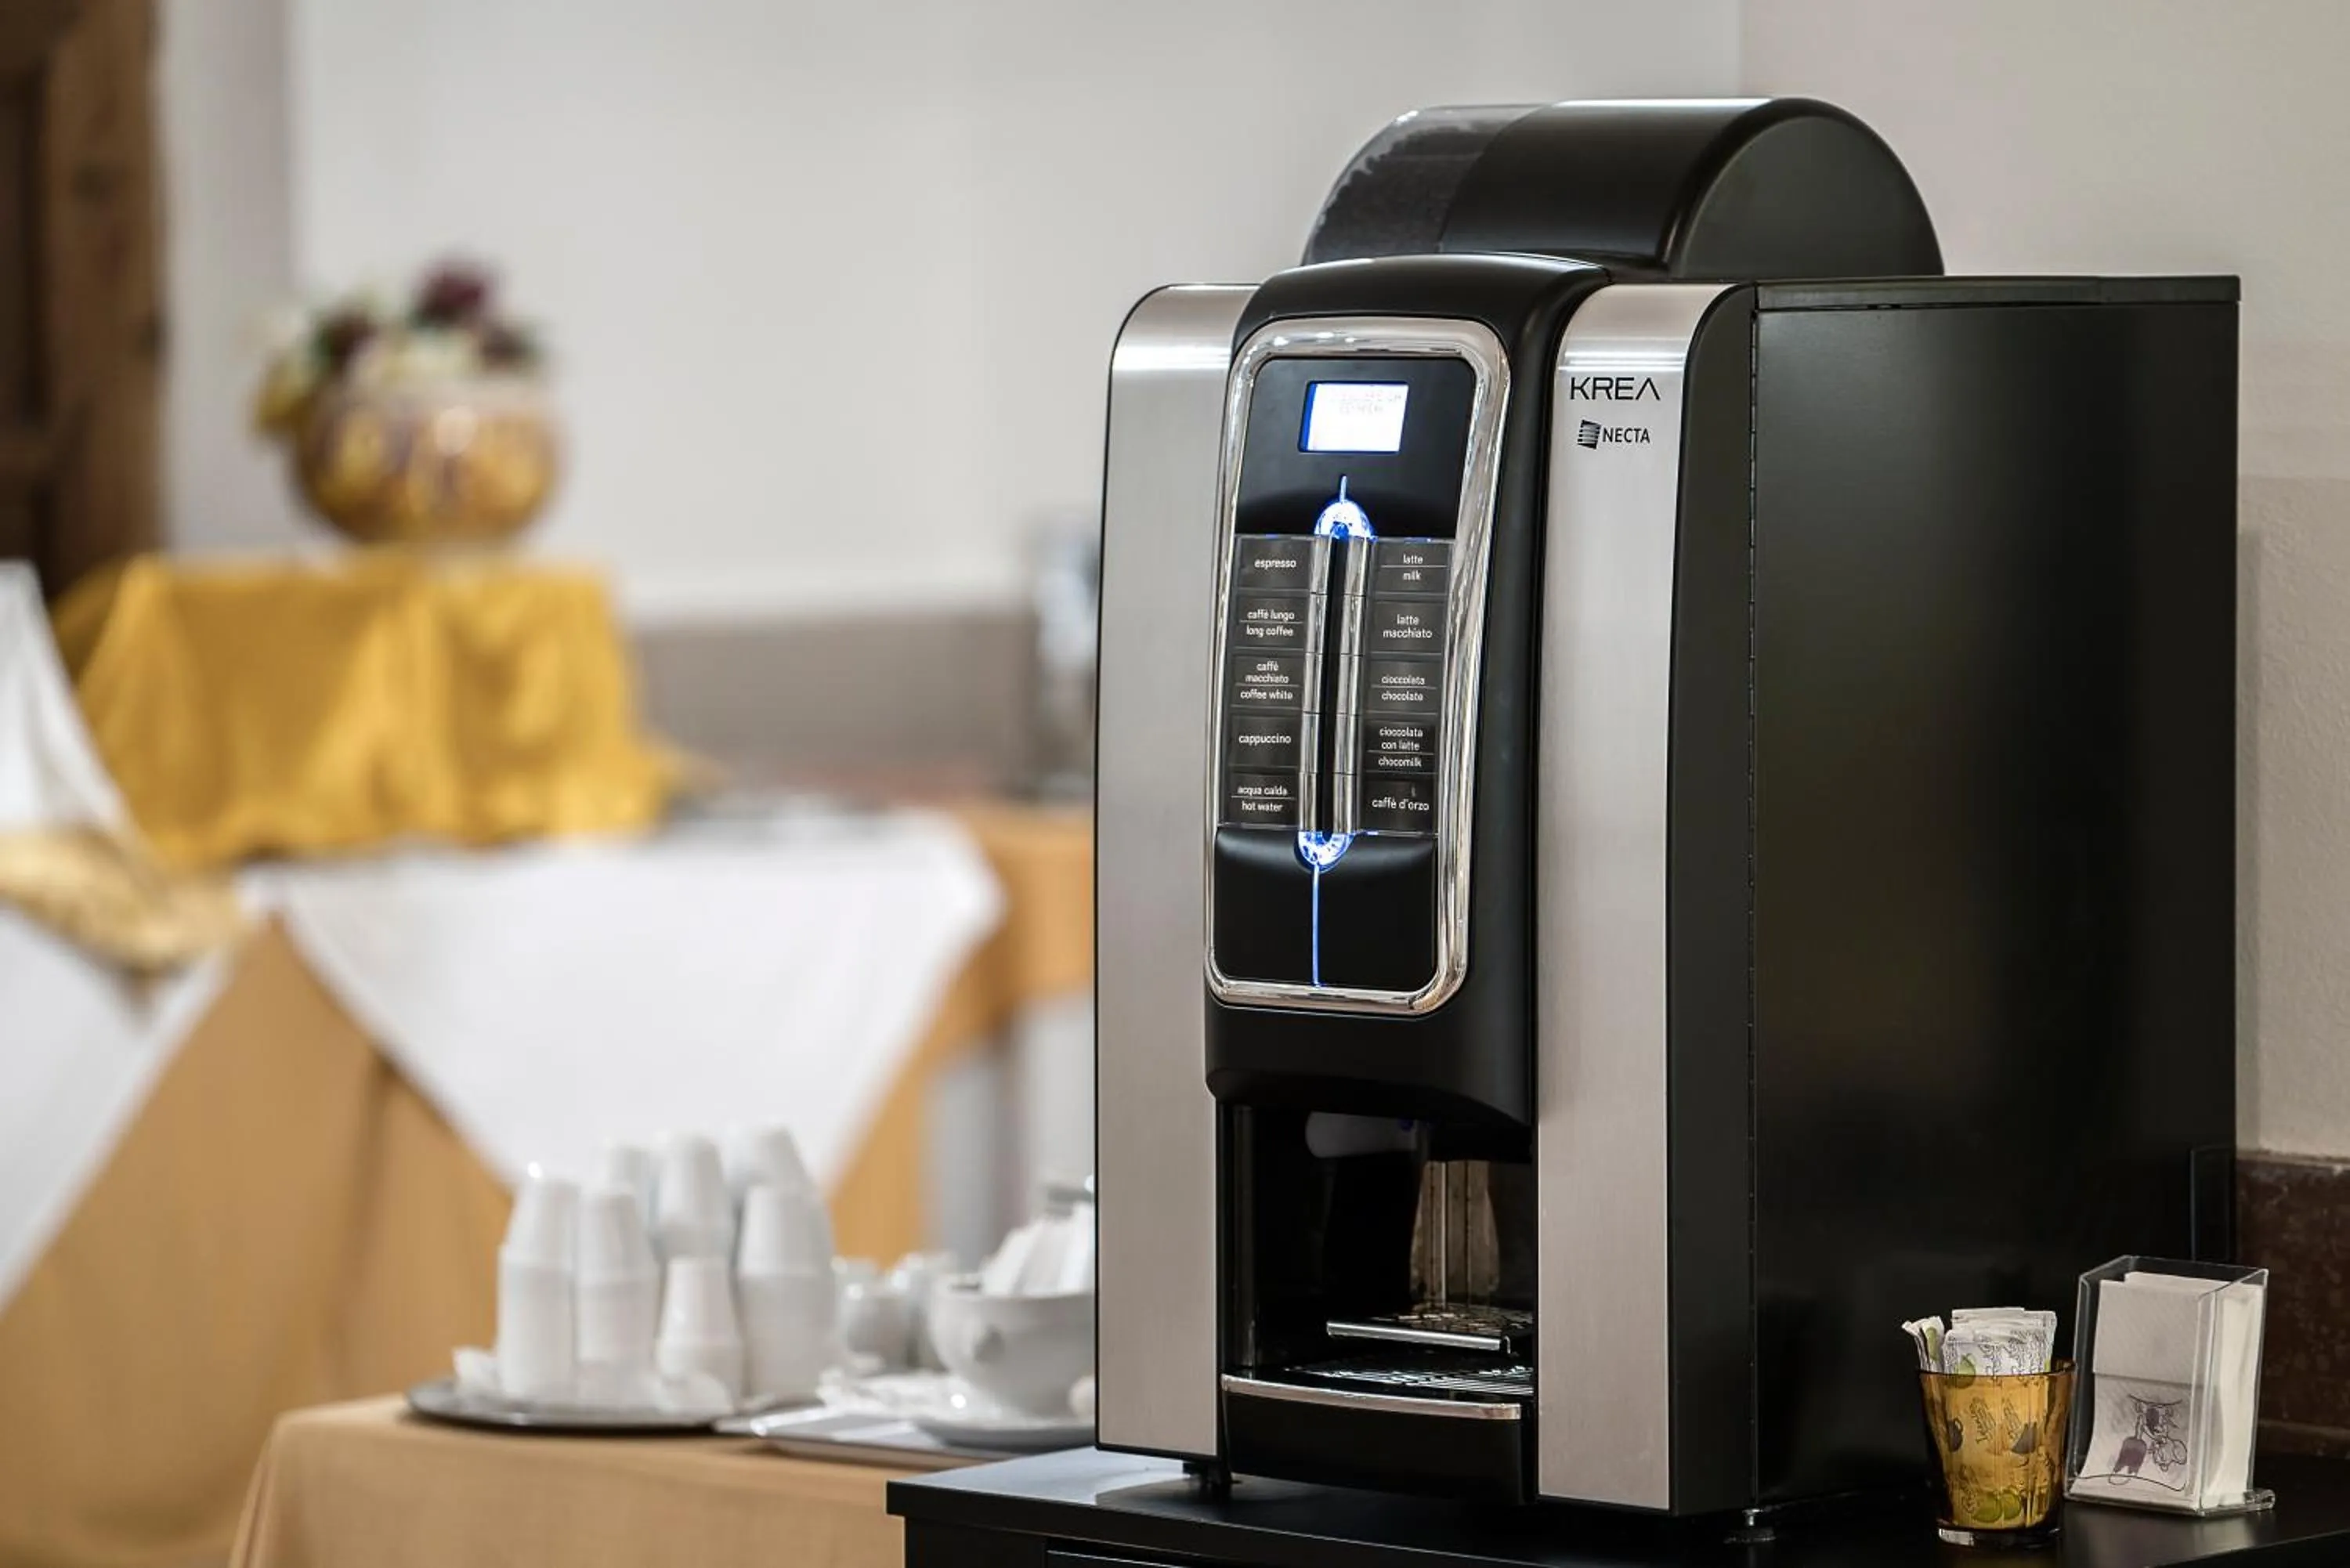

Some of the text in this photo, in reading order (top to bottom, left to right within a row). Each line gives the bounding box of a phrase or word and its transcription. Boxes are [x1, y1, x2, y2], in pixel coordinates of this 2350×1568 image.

[1603, 428, 1650, 443] NECTA
[1254, 558, 1296, 570] espresso
[1403, 554, 1423, 564] latte
[1403, 569, 1422, 580] milk
[1270, 609, 1295, 621] lungo
[1397, 614, 1419, 625] latte
[1246, 624, 1294, 638] long coffee
[1383, 627, 1433, 638] macchiato
[1245, 674, 1289, 684] macchiato
[1381, 674, 1425, 685] cioccolata
[1240, 688, 1293, 699] coffee white
[1381, 691, 1423, 701] chocolate
[1379, 727, 1423, 737] cioccolata
[1238, 733, 1292, 746] cappuccino
[1398, 739, 1420, 750] latte
[1378, 756, 1422, 767] chocomilk
[1237, 785, 1288, 796] acqua calda
[1242, 800, 1283, 811] hot water
